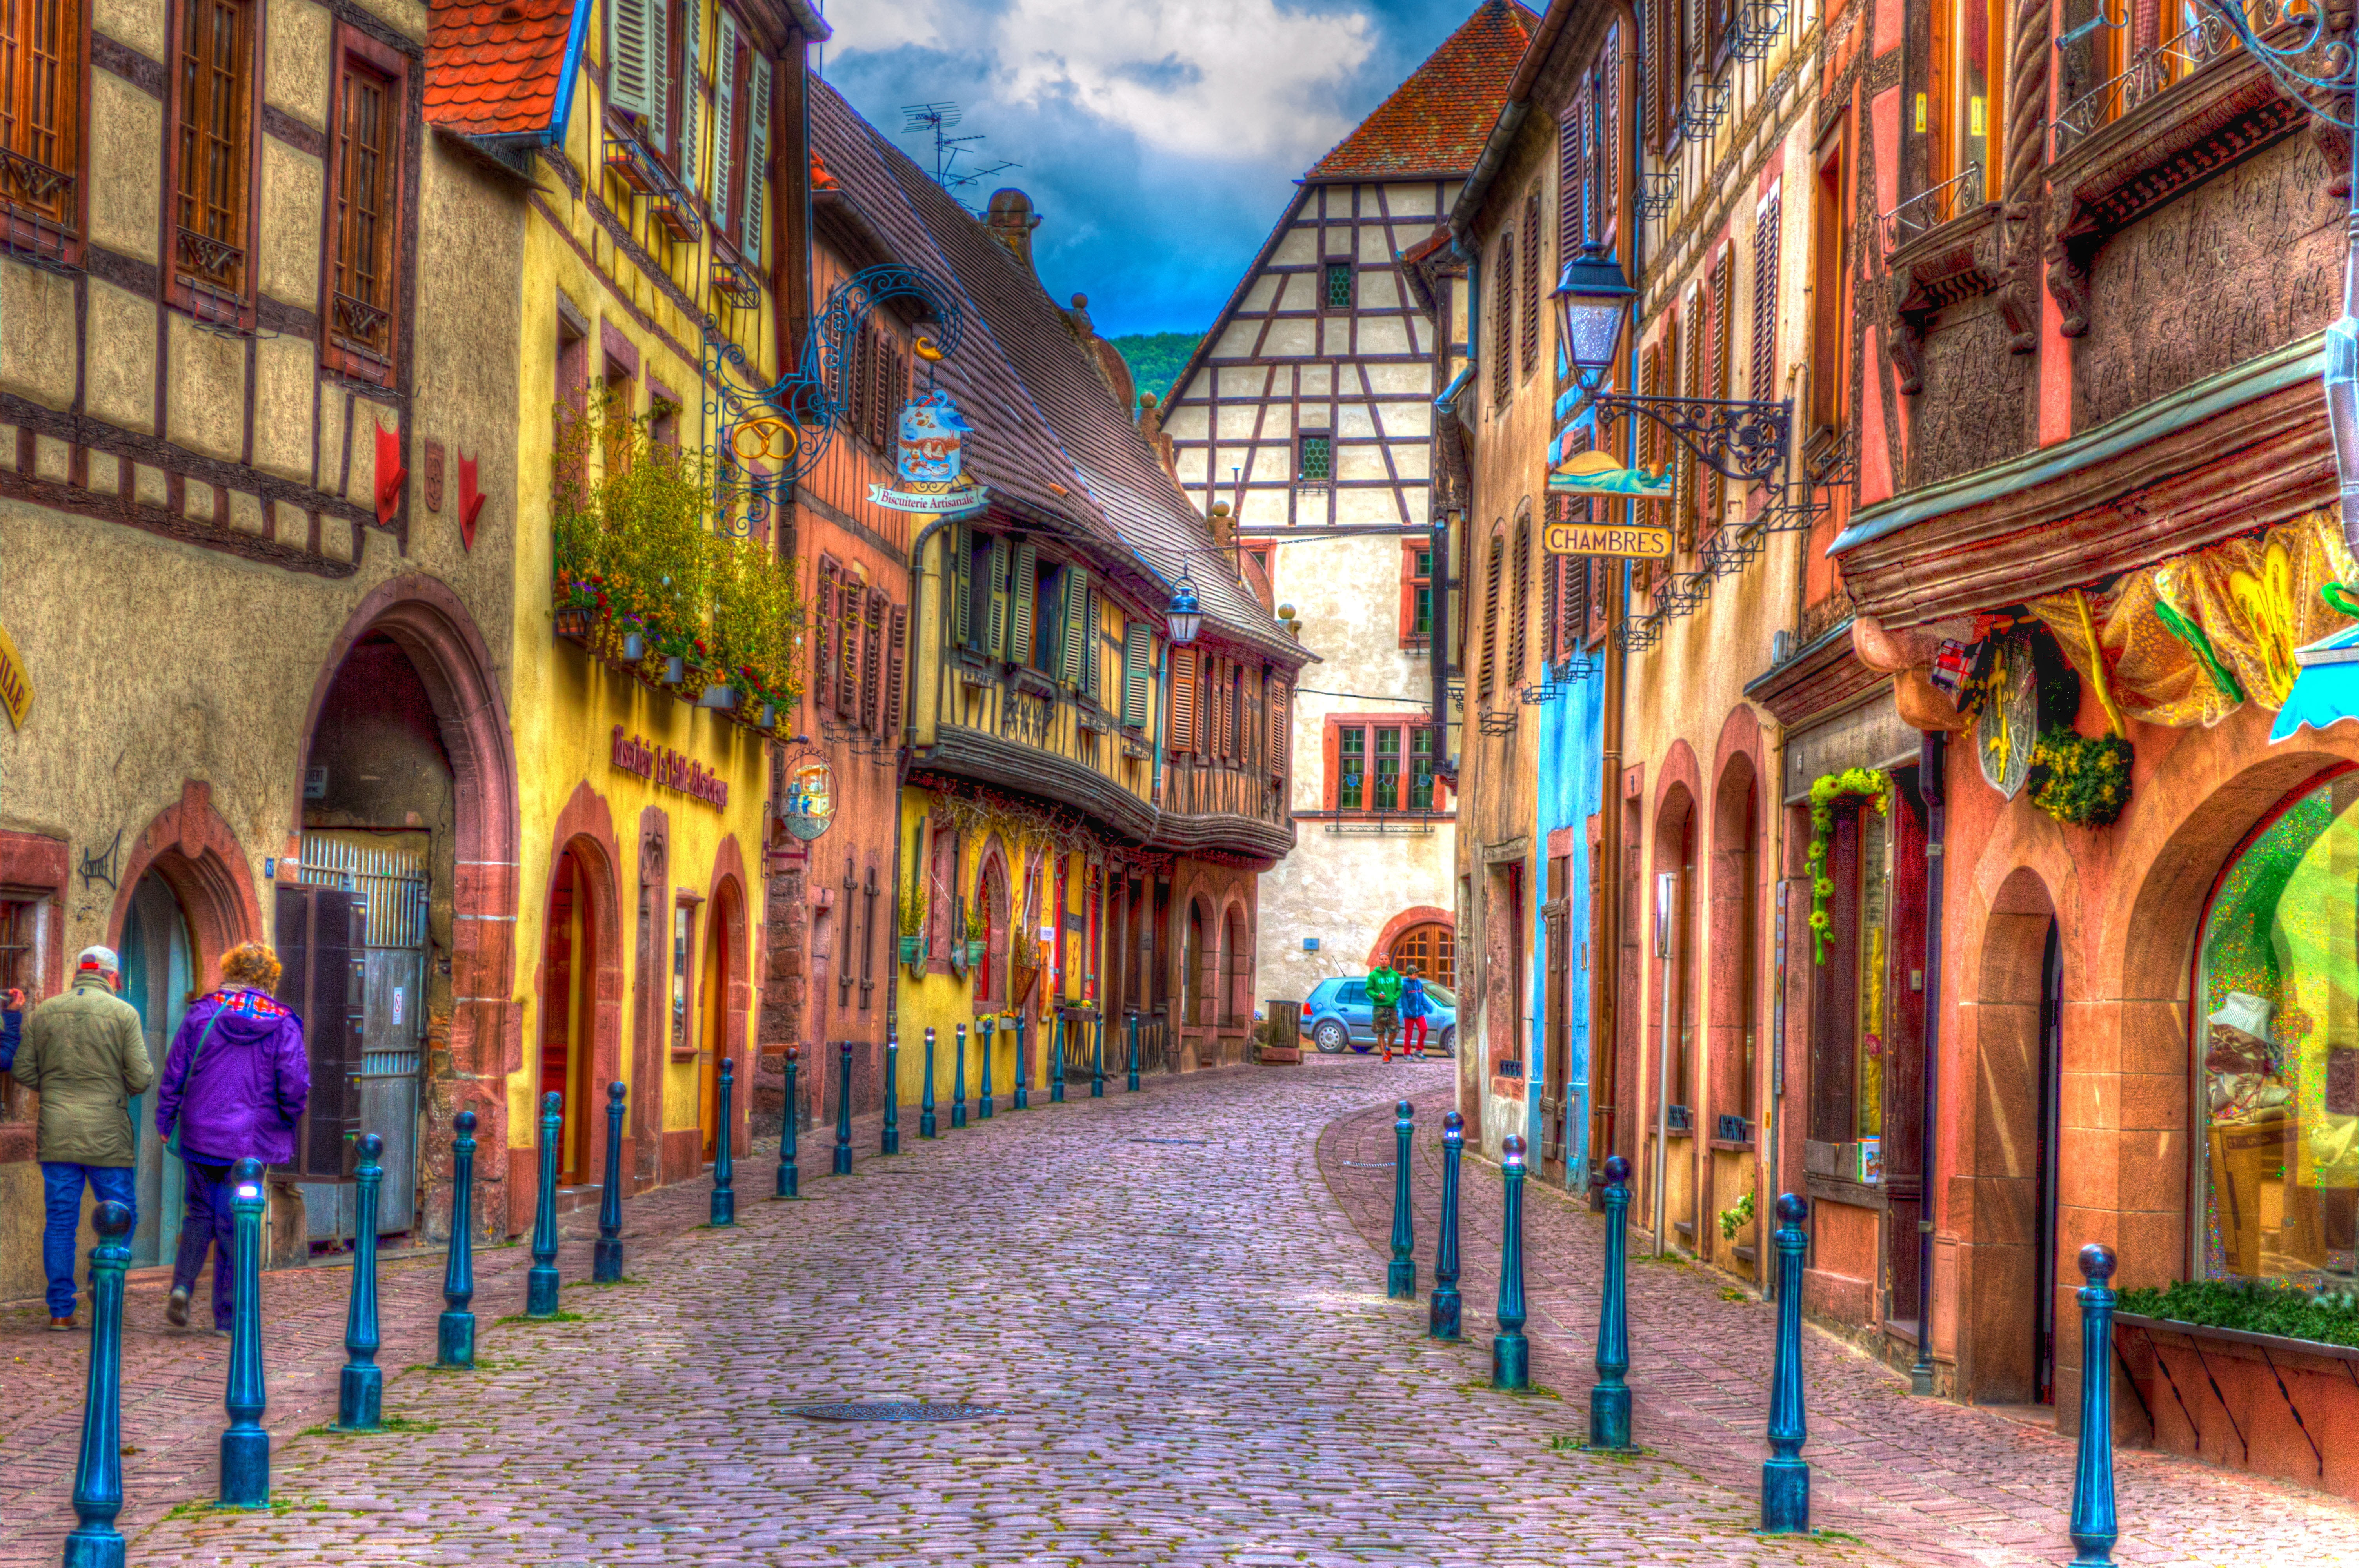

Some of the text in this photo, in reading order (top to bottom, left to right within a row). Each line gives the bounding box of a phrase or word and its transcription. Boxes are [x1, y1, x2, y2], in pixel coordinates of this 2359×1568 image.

[881, 491, 974, 509] Biscuiterie Artisanale
[1551, 528, 1664, 554] CHAMBRES
[612, 724, 653, 780] Biscuiterie
